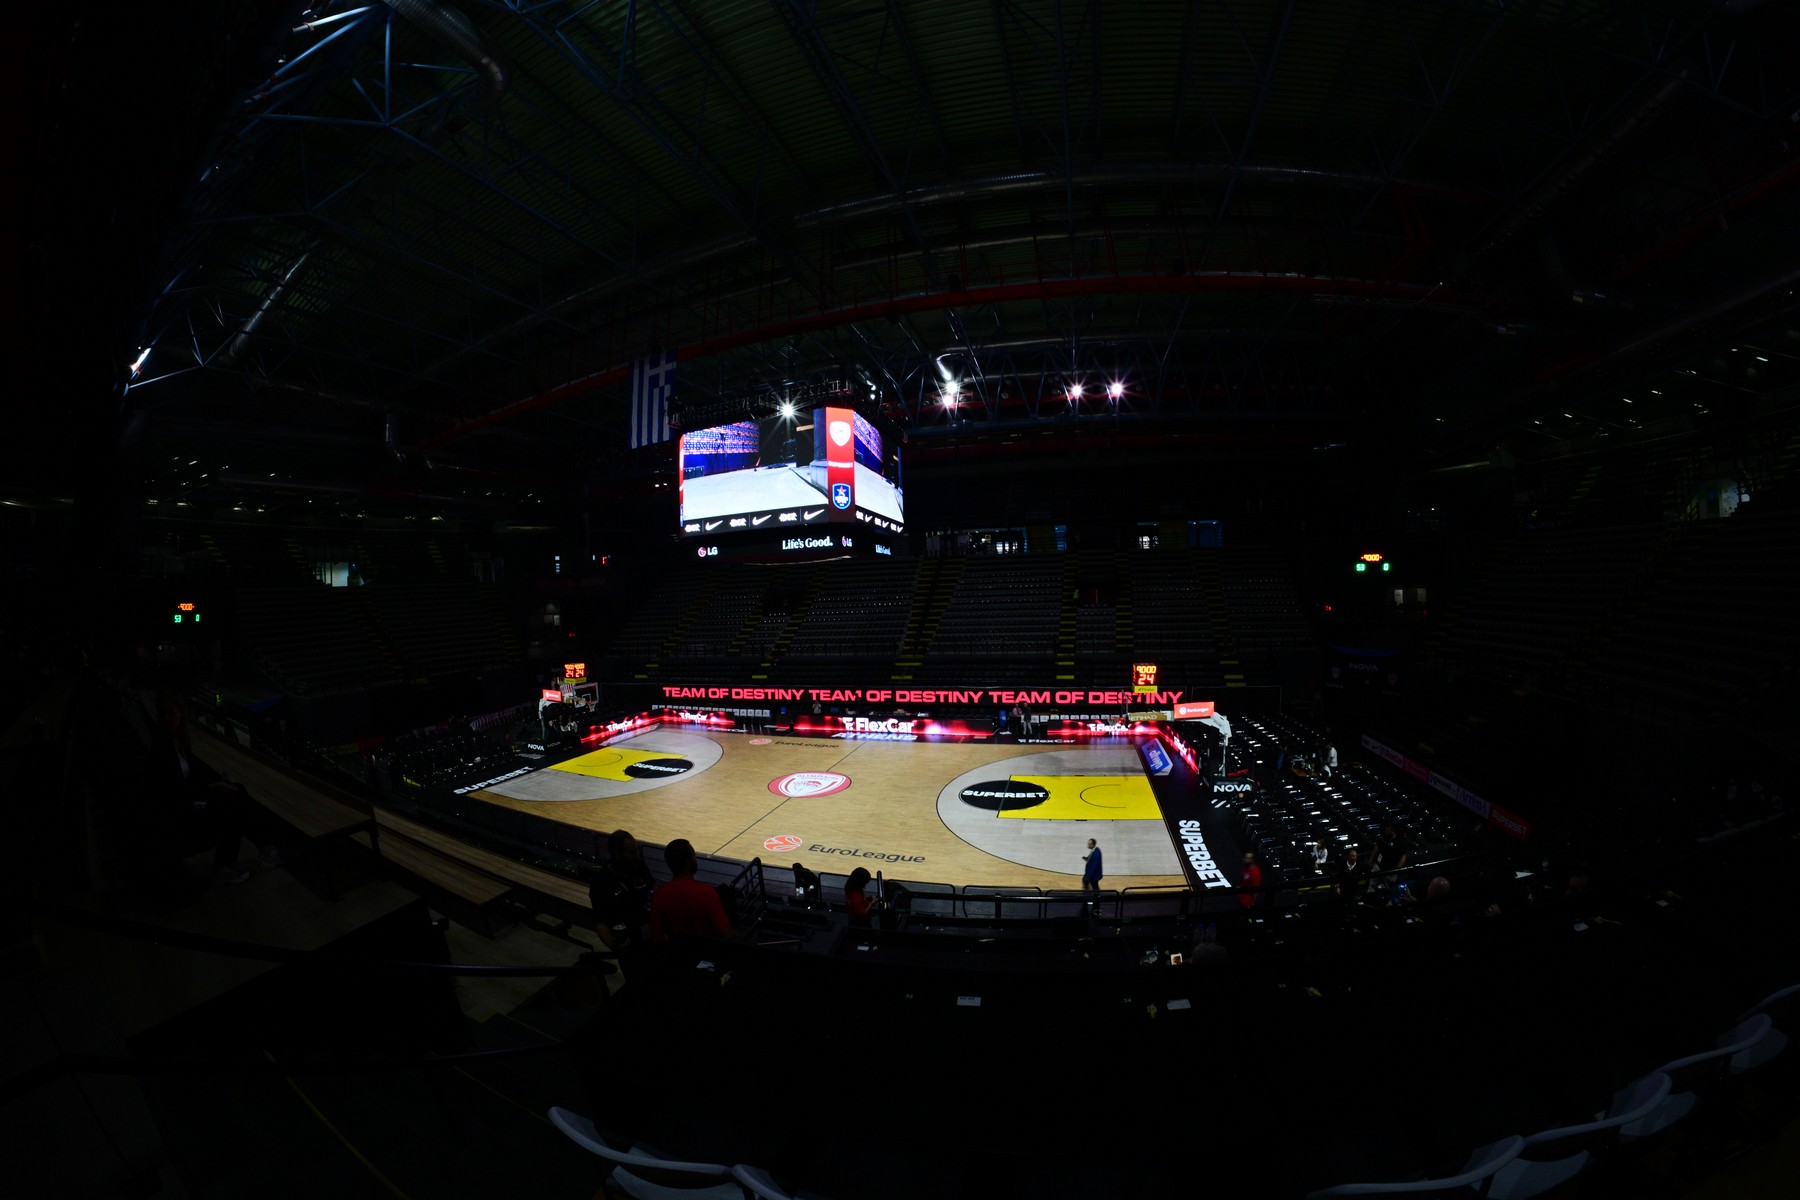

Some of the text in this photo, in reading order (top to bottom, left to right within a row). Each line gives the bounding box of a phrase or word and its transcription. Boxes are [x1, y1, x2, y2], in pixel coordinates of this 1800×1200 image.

[782, 536, 833, 550] Life's Good.
[707, 547, 718, 556] LG
[1138, 674, 1155, 685] 24
[662, 687, 704, 698] TEAM
[708, 688, 729, 698] OF
[731, 688, 804, 700] DESTINY
[809, 690, 861, 701] TEAM
[866, 690, 891, 702] OF
[895, 691, 983, 703] DESTINY
[988, 691, 1050, 704] TEAM
[1055, 691, 1085, 704] OF
[855, 718, 915, 733] FlexCar
[527, 743, 545, 751] NOVA
[962, 790, 1045, 798] SUPERBET
[1213, 784, 1252, 792] NOVA
[808, 844, 926, 863] EuroLeague
[1179, 820, 1232, 888] SUPERBET
